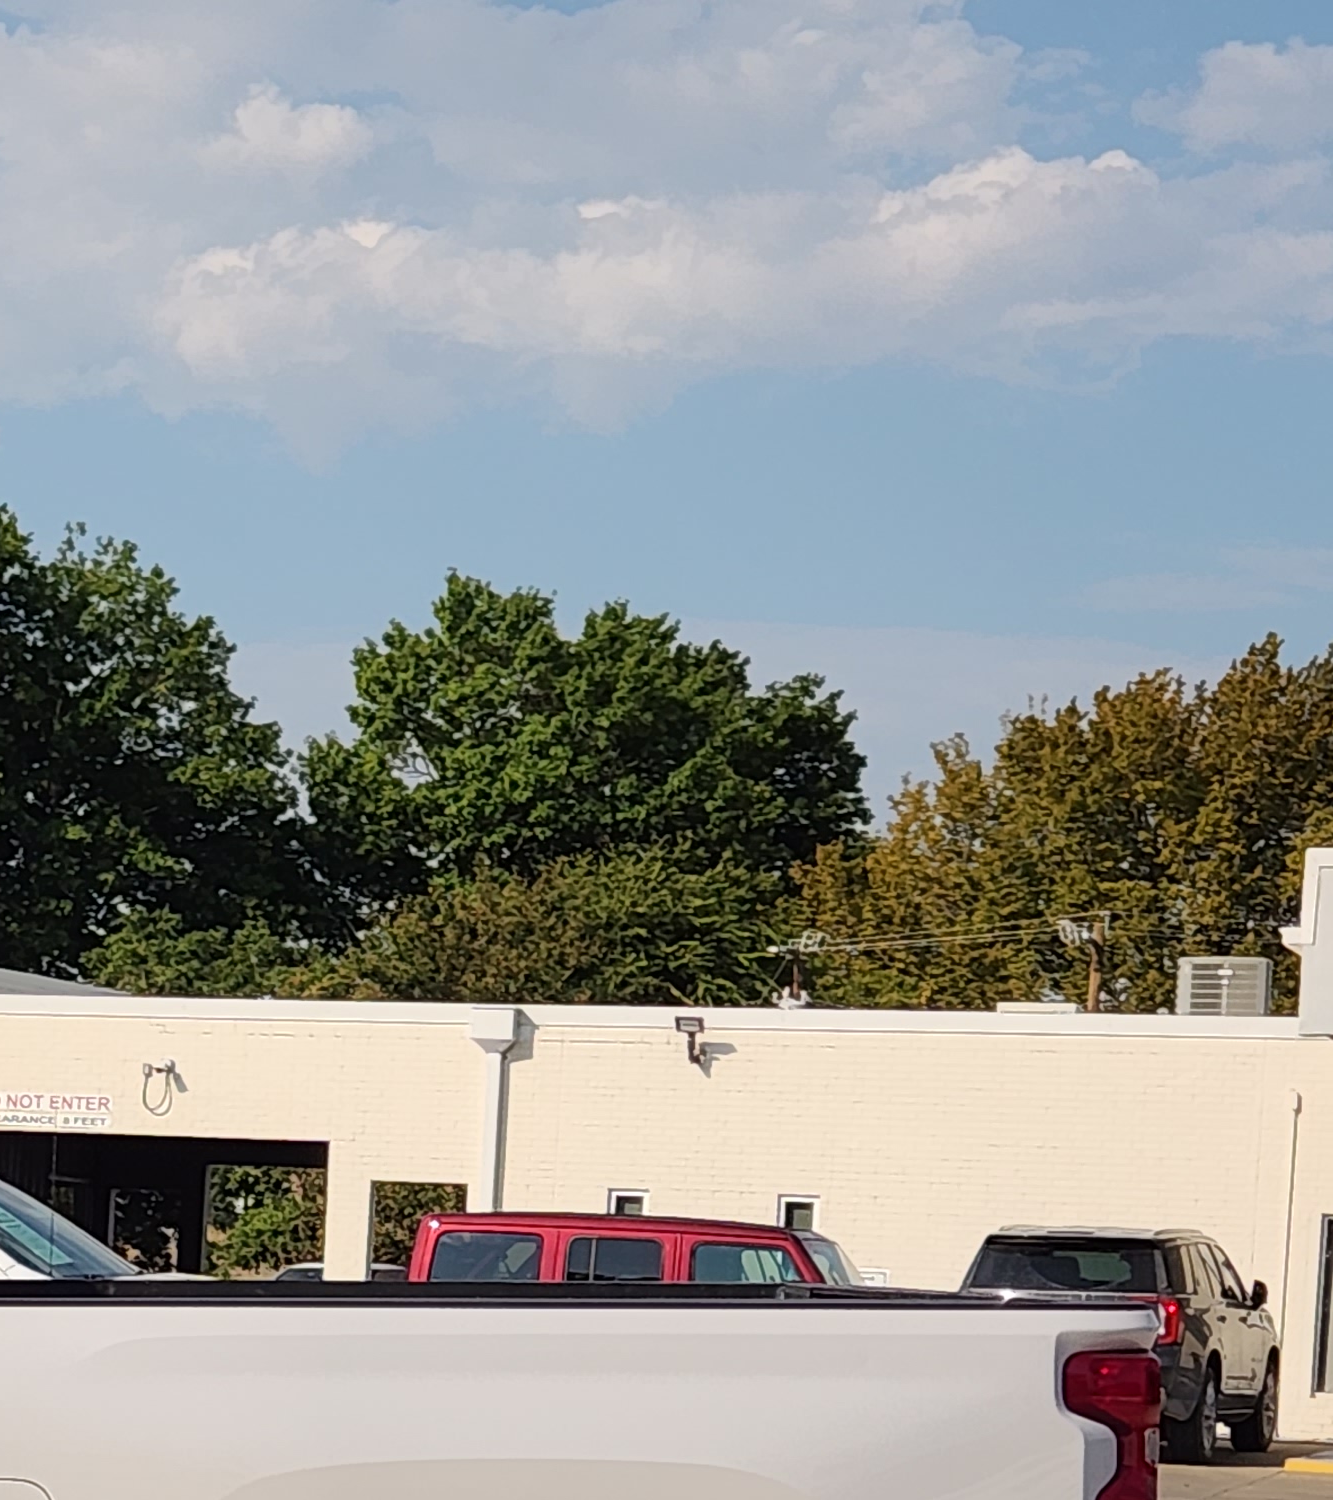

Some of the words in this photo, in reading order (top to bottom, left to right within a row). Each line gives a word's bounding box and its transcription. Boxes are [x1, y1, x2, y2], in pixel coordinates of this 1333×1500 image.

[6, 1094, 44, 1109] NOT
[49, 1095, 111, 1111] ENTER
[73, 1117, 108, 1126] FEET
